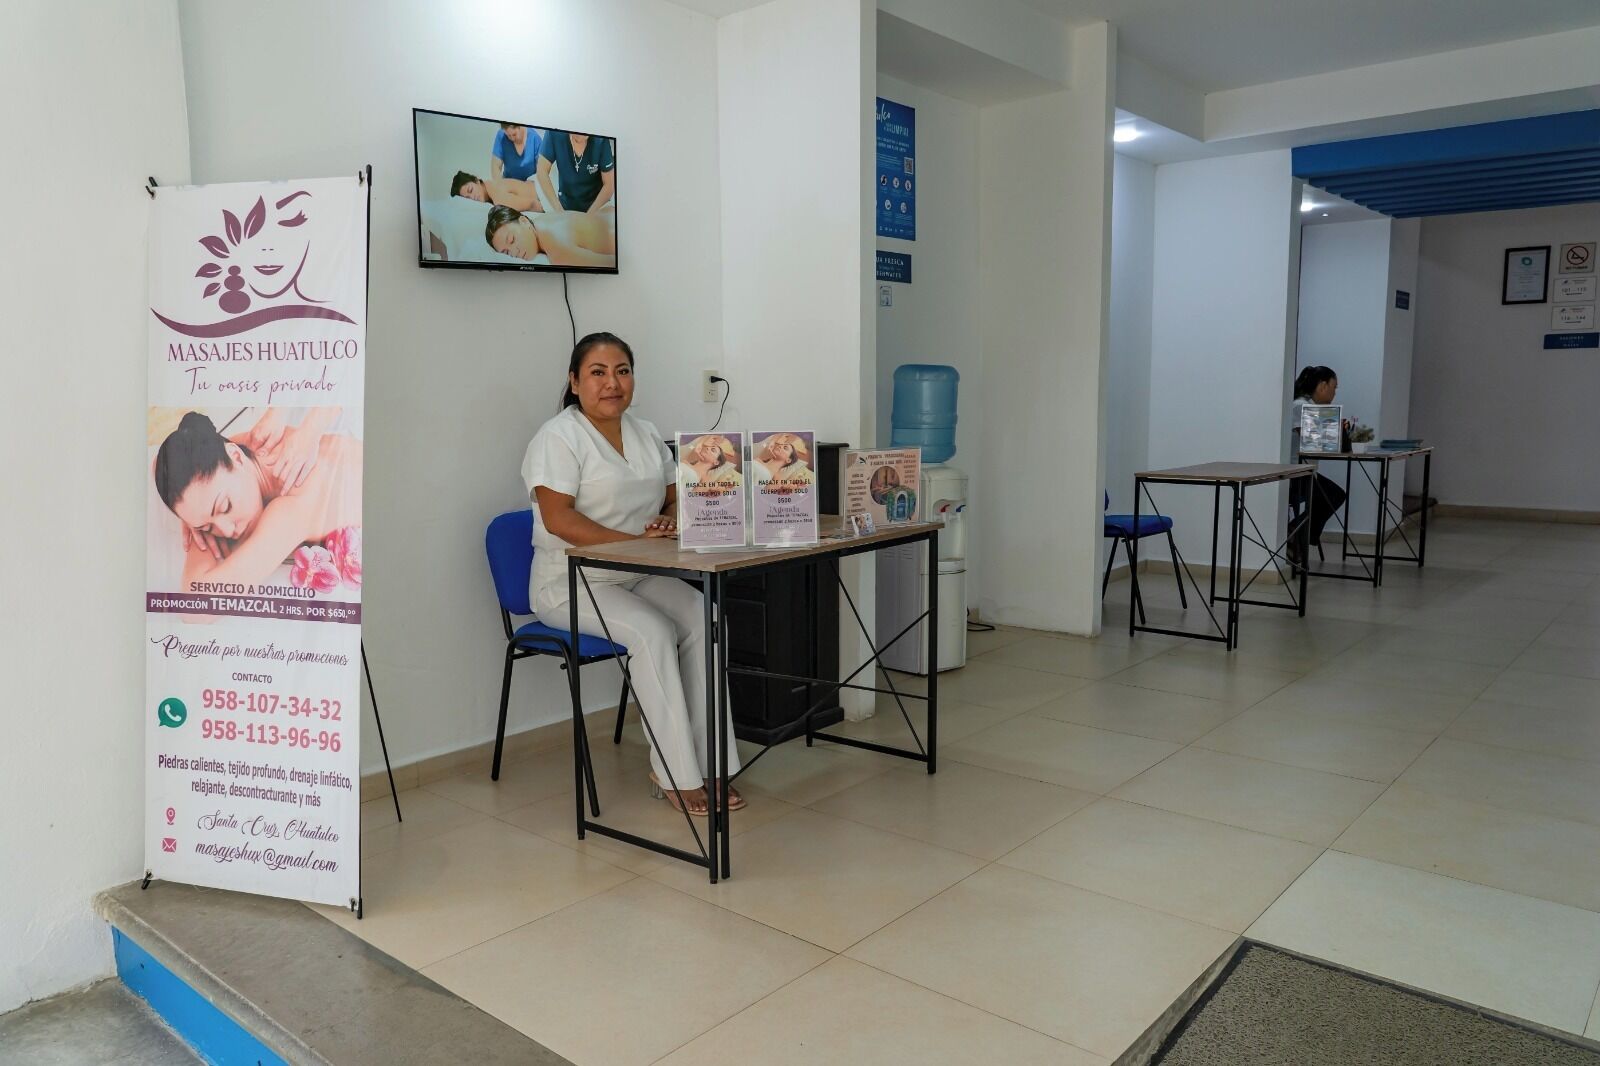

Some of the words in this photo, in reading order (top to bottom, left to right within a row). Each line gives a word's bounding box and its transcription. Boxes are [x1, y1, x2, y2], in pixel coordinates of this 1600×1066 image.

[168, 342, 253, 362] MASAJES
[258, 339, 358, 361] HUATULCO
[185, 366, 210, 395] Tu
[218, 379, 260, 393] oasis
[268, 365, 337, 404] privado
[190, 581, 245, 594] SERVICIO
[247, 584, 255, 595] A
[258, 585, 316, 599] DOMICILIO
[150, 597, 209, 610] PROMOCIÓN
[210, 597, 277, 614] TEMAZCAL
[279, 605, 285, 614] 2
[286, 605, 304, 616] HRS.
[306, 607, 326, 617] POR
[150, 633, 220, 660] Pregunta
[222, 643, 242, 662] por
[244, 642, 285, 661] nuestras
[287, 648, 350, 667] promociones
[232, 672, 273, 684] CONTACTO
[202, 688, 342, 722] 958-107-34-32
[201, 718, 341, 753] 958-113-96-96
[158, 754, 189, 770] Piedras
[190, 758, 227, 775] calientes,
[228, 761, 250, 780] tejido
[252, 763, 288, 782] profundo,
[289, 767, 318, 785] drenaje
[320, 770, 353, 791] linfático,
[191, 778, 228, 798] relajante,
[229, 783, 297, 804] descontracturante
[299, 795, 304, 808] y
[305, 791, 321, 807] más
[197, 809, 238, 831] Santa
[284, 819, 340, 843] Huatulco
[195, 840, 339, 873] masajeshux@gmail.com
